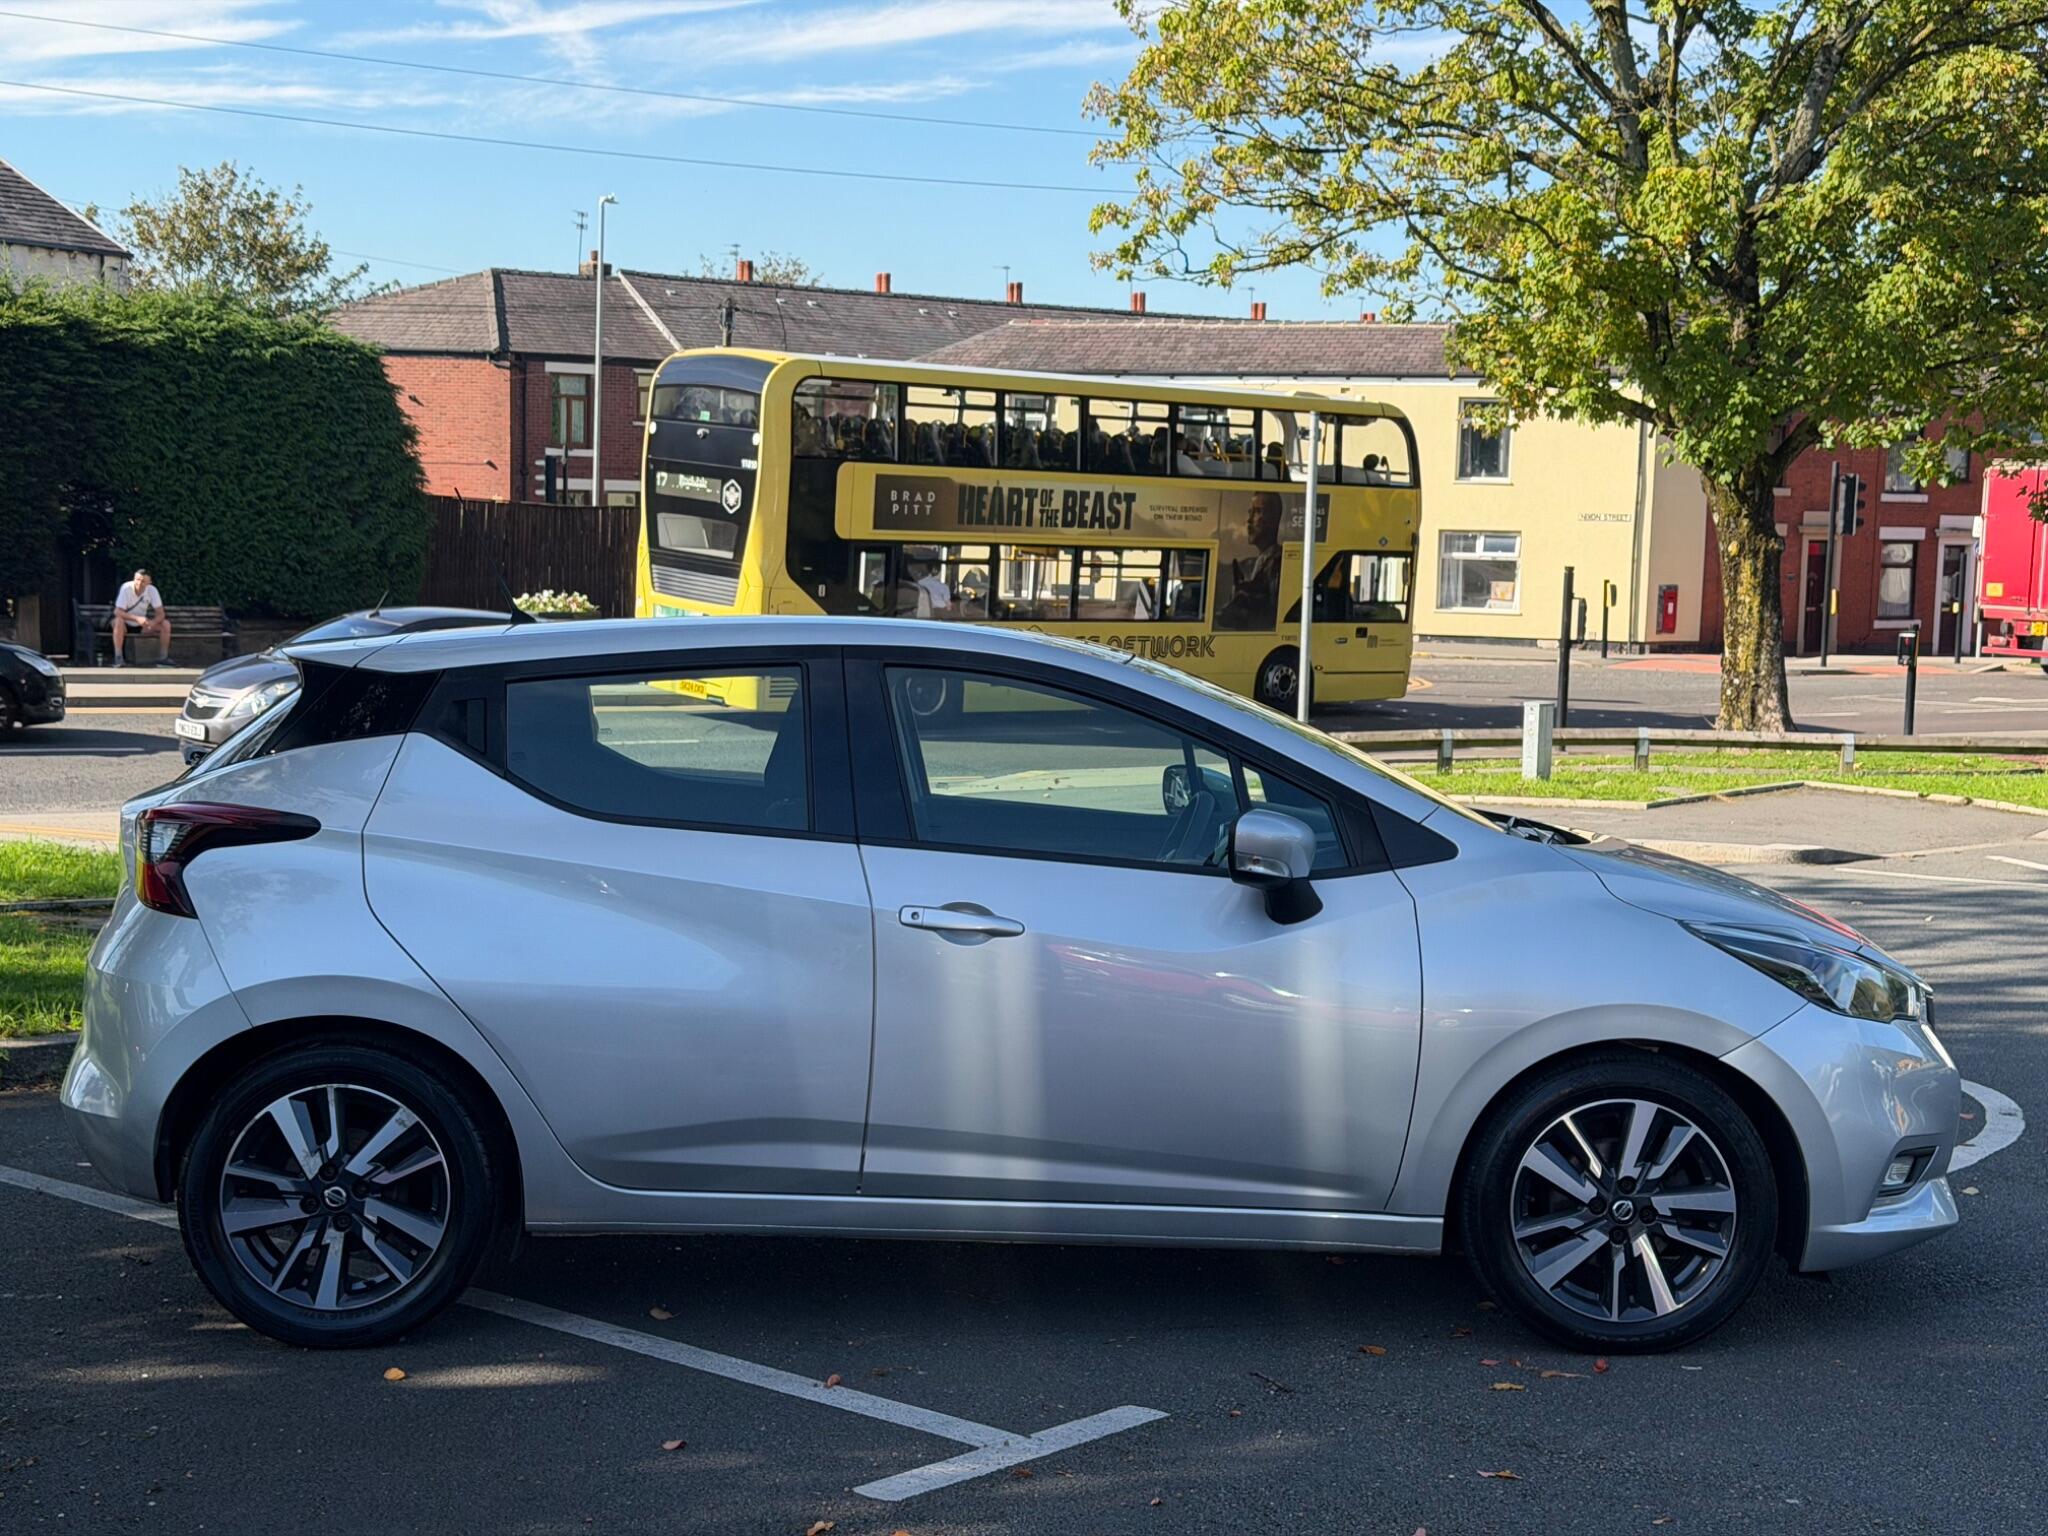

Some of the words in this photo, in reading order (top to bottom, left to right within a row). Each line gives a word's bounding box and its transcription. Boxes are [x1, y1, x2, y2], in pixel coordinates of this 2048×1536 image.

[656, 471, 668, 487] 17
[890, 490, 936, 503] BRAD
[957, 484, 1038, 527] HEART
[1040, 488, 1055, 508] OF
[892, 503, 932, 515] PITT
[1039, 508, 1060, 528] THE
[1061, 489, 1137, 530] BEAST
